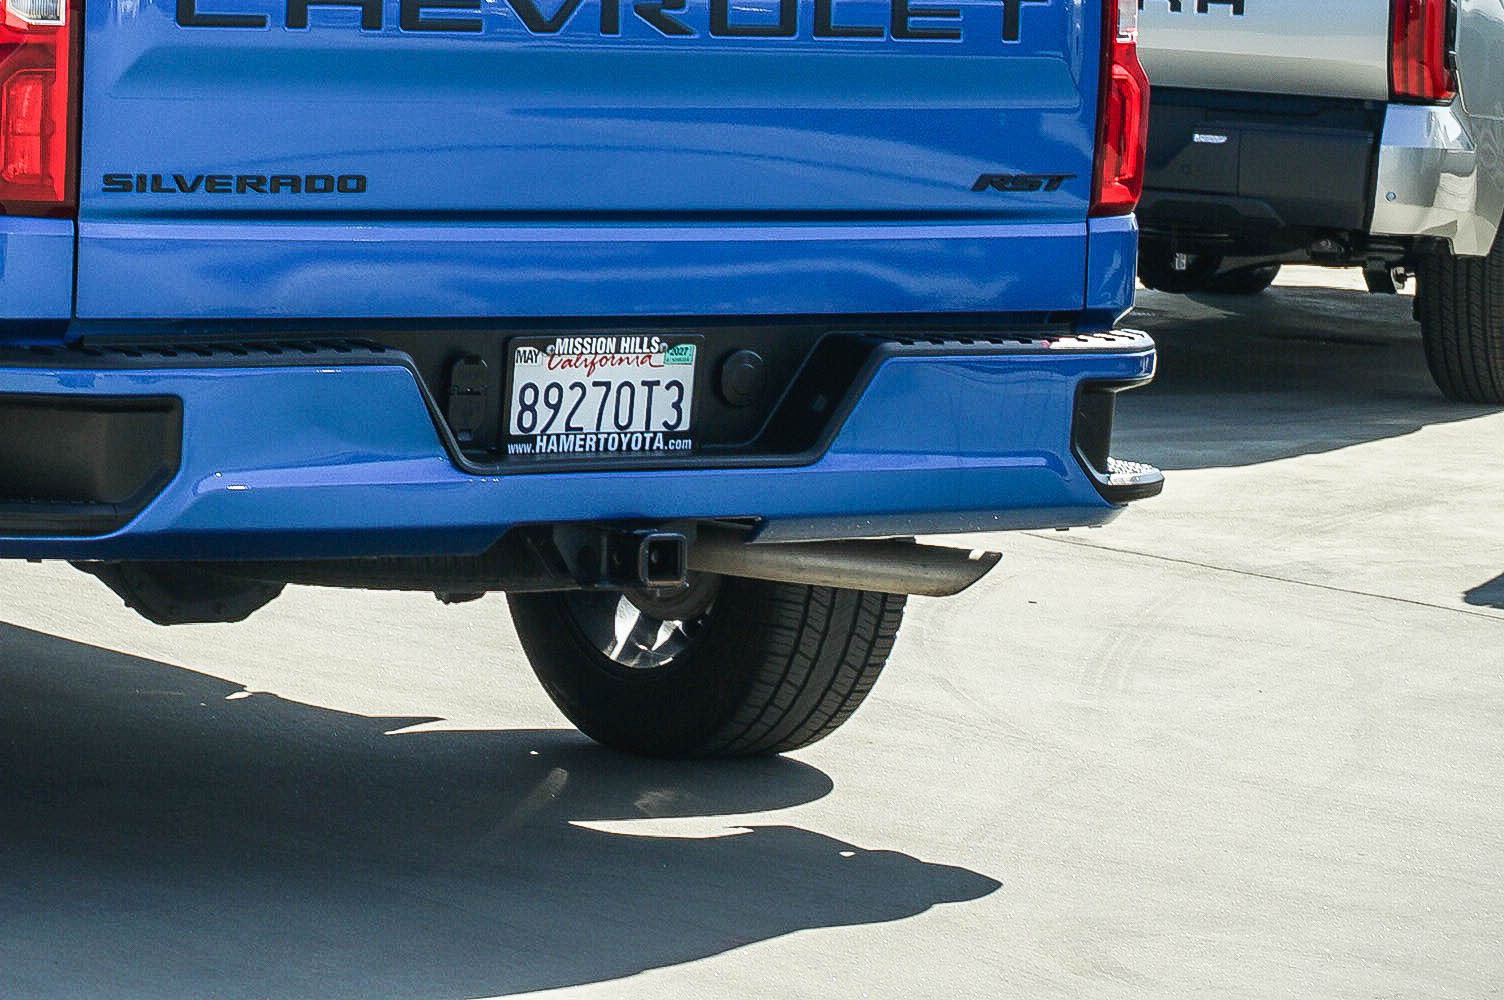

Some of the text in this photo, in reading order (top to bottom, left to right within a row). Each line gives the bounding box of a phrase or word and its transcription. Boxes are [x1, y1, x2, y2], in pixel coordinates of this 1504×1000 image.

[101, 173, 367, 194] SILVERADO
[970, 173, 1078, 192] RST
[554, 336, 661, 355] MISSION HILLS
[515, 349, 540, 364] MAY
[547, 353, 665, 377] California
[516, 379, 685, 434] 89270T3
[507, 432, 693, 455] www.HAMERTOYOTA.com
